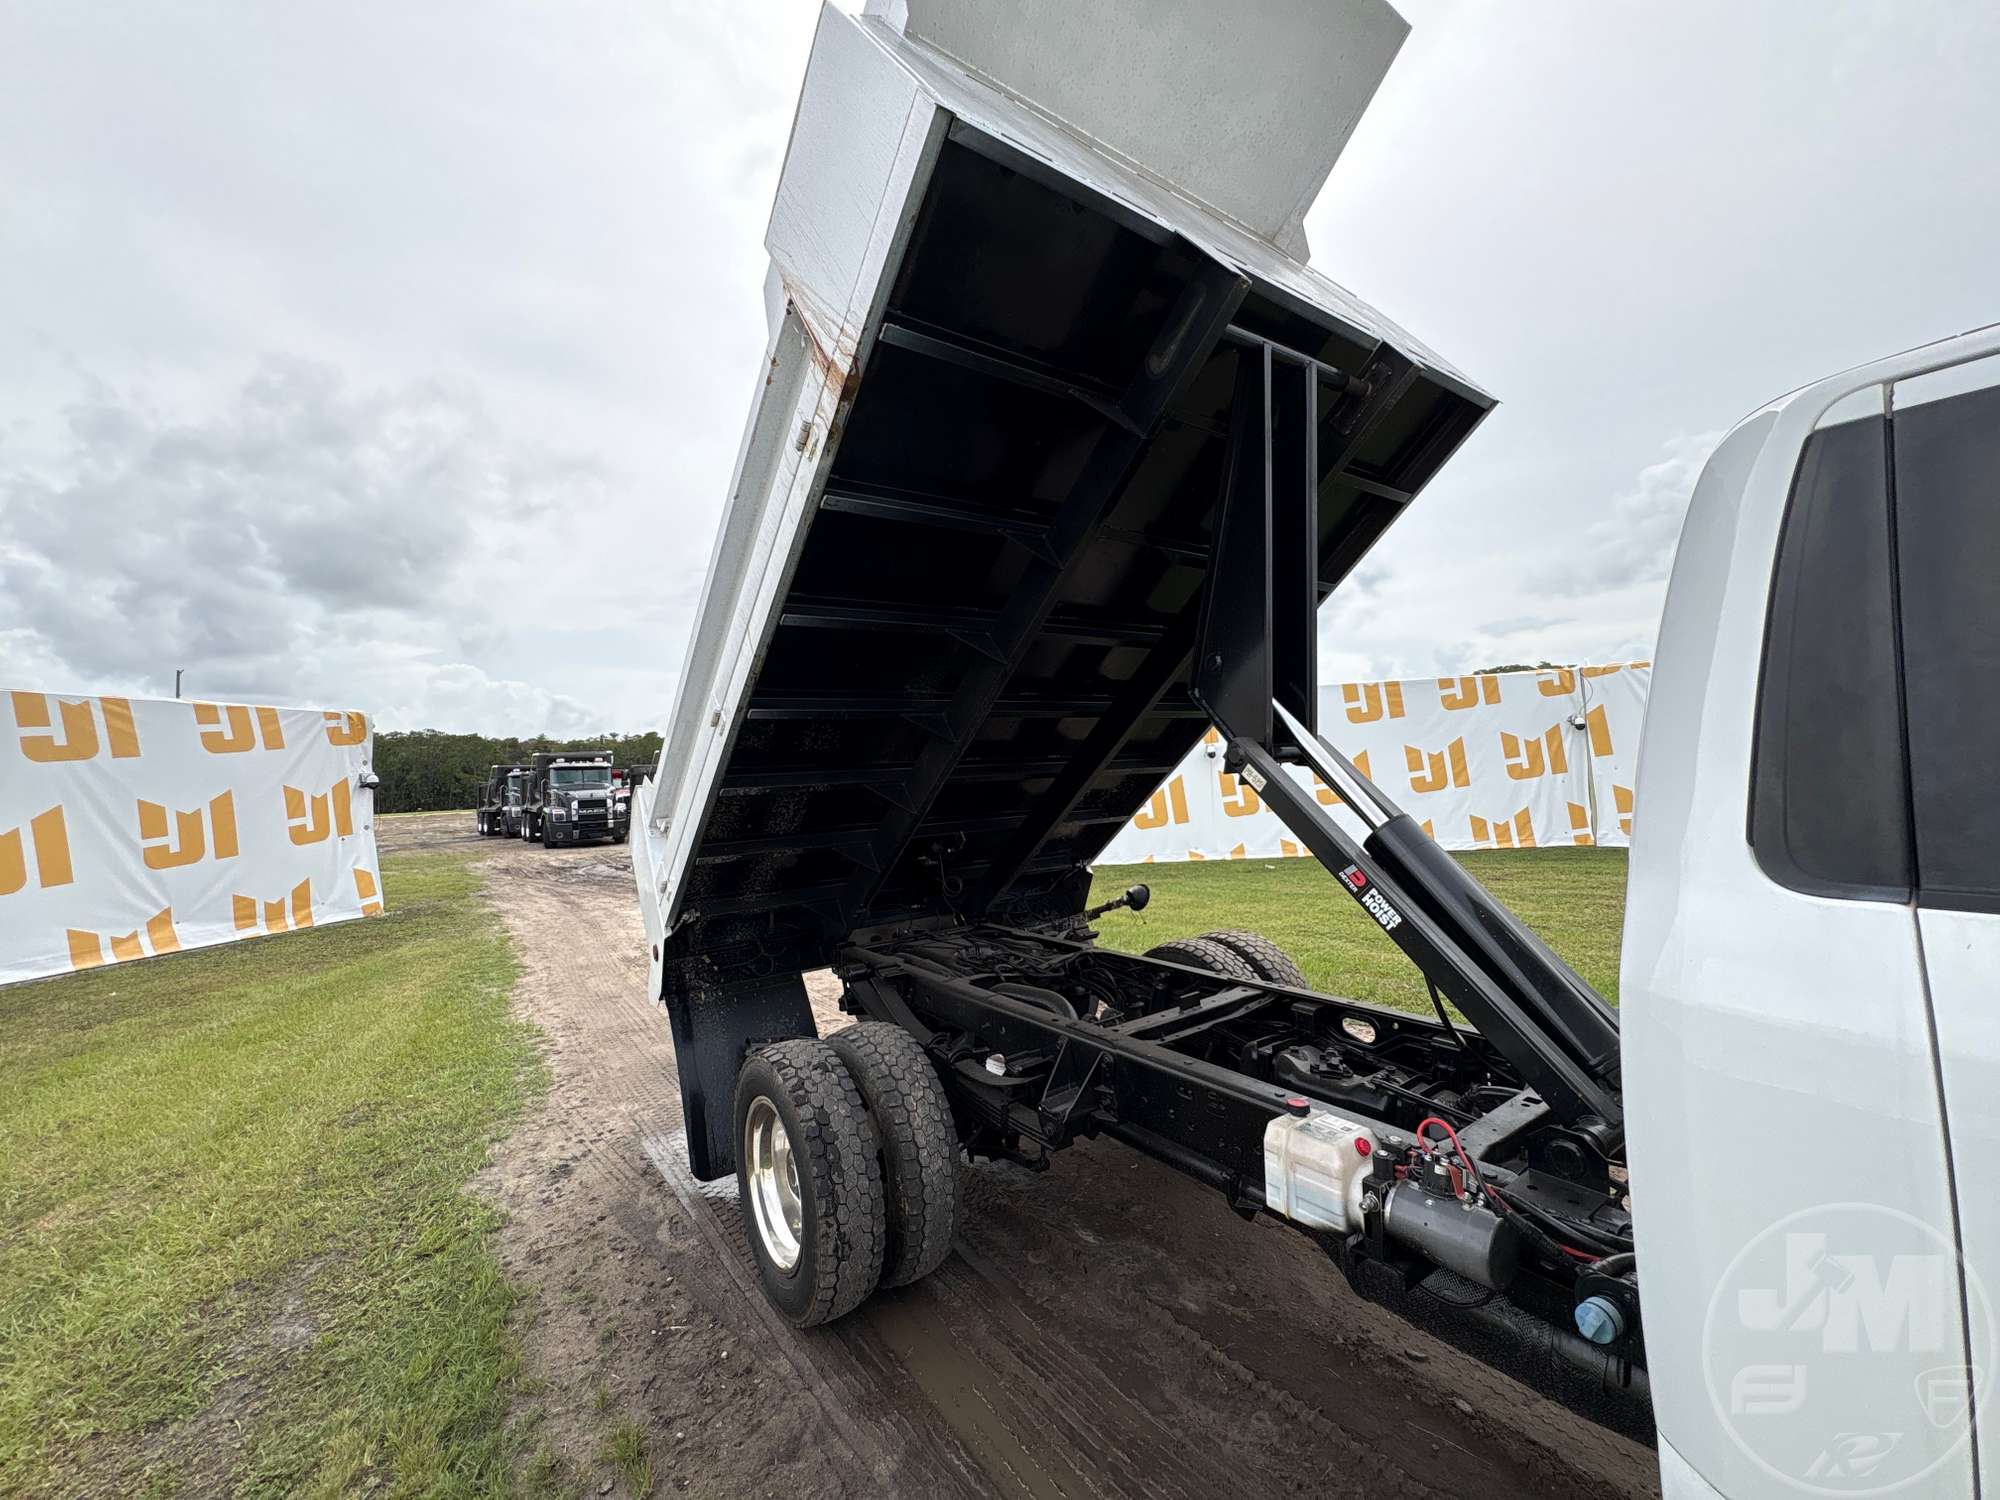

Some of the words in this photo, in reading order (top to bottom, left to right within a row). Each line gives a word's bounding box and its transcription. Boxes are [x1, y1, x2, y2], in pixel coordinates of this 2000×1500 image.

[1338, 871, 1358, 893] DEXTER
[1361, 893, 1397, 931] HOIST
[1369, 887, 1402, 925] POWER
